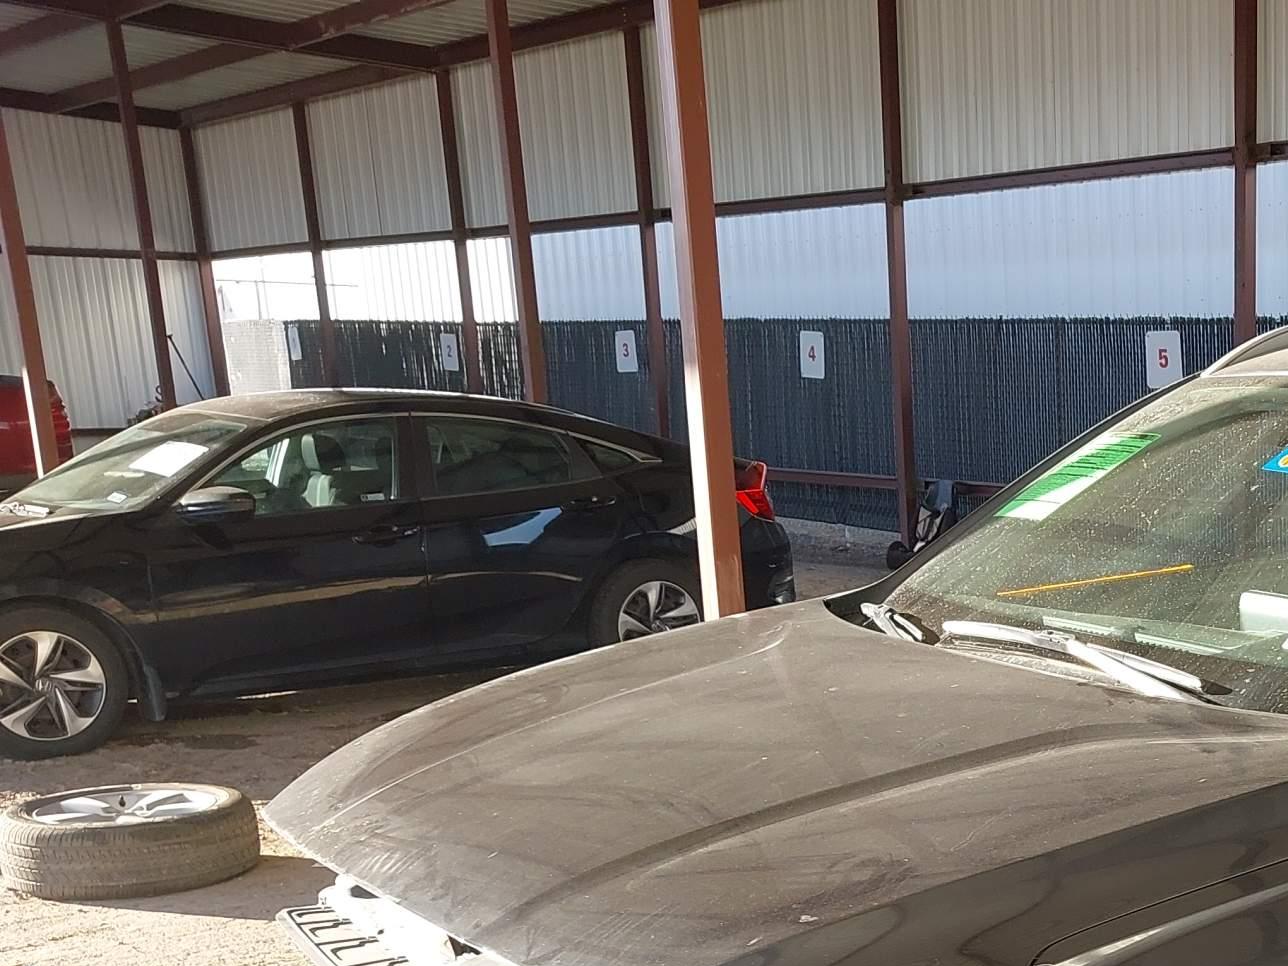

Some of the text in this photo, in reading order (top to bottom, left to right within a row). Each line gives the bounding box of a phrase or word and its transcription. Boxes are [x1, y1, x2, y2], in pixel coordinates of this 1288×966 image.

[446, 344, 453, 358] 2
[622, 342, 630, 358] 3
[808, 344, 817, 362] 4
[1158, 348, 1169, 369] 5
